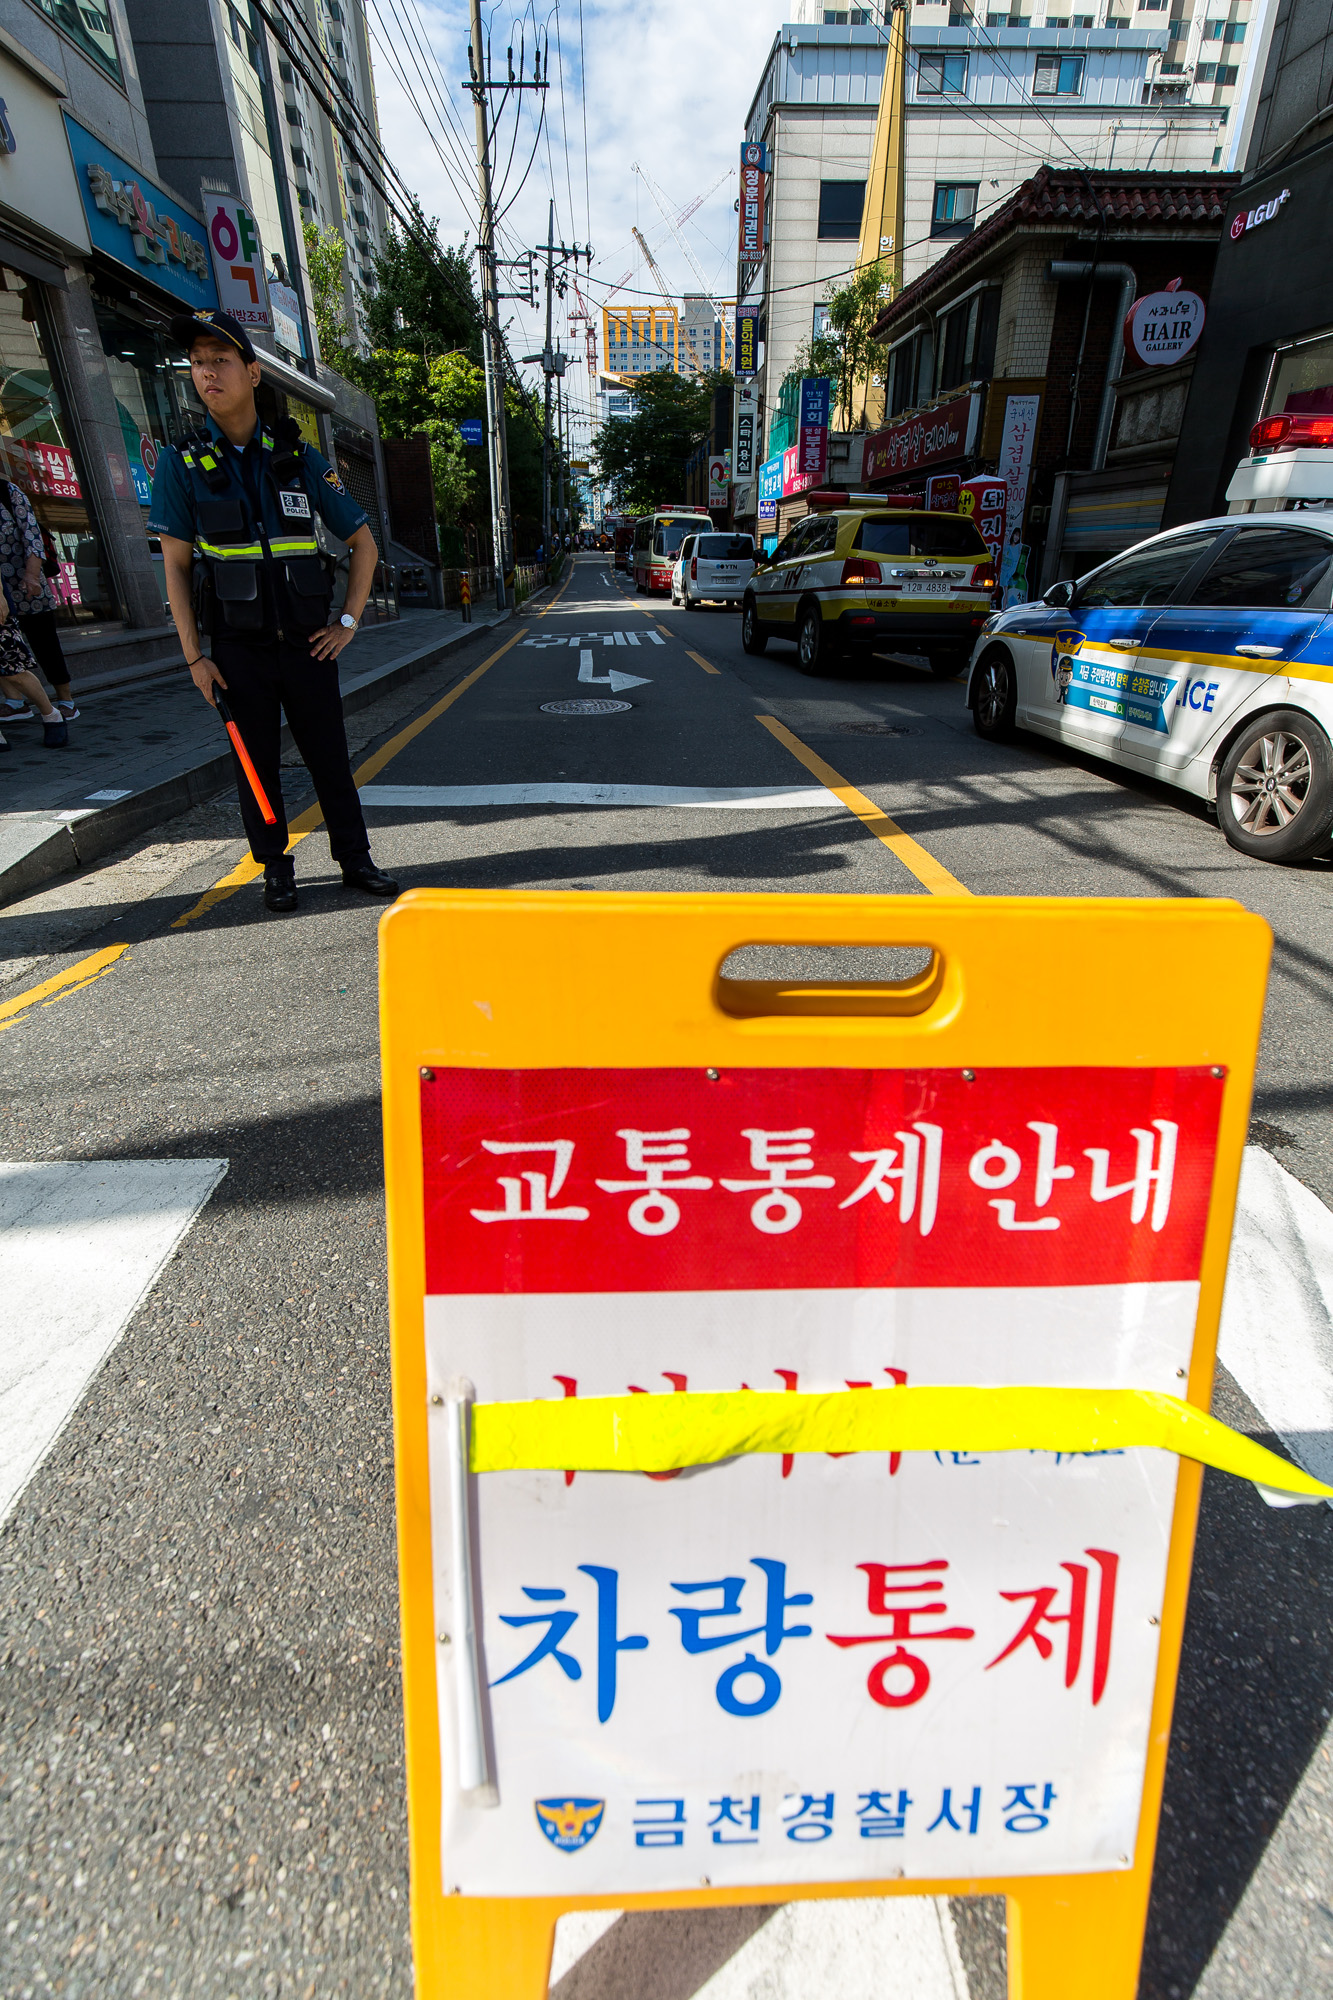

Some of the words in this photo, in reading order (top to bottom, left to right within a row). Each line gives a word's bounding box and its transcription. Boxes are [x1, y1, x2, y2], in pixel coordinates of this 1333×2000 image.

[211, 206, 258, 305] 약
[1149, 302, 1190, 316] 사과나무
[740, 318, 753, 370] 음악학원
[1142, 321, 1192, 342] HAIR
[1145, 341, 1183, 352] GALLERY
[806, 398, 824, 425] 교회
[738, 418, 753, 472] 스타미용실
[804, 435, 821, 471] 부동산
[1004, 422, 1031, 486] 삼겹살
[286, 507, 308, 515] POLICE
[1079, 664, 1090, 680] 지금
[487, 1548, 1119, 1724] 차량통제
[632, 1782, 1058, 1848] 금천경찰서장
